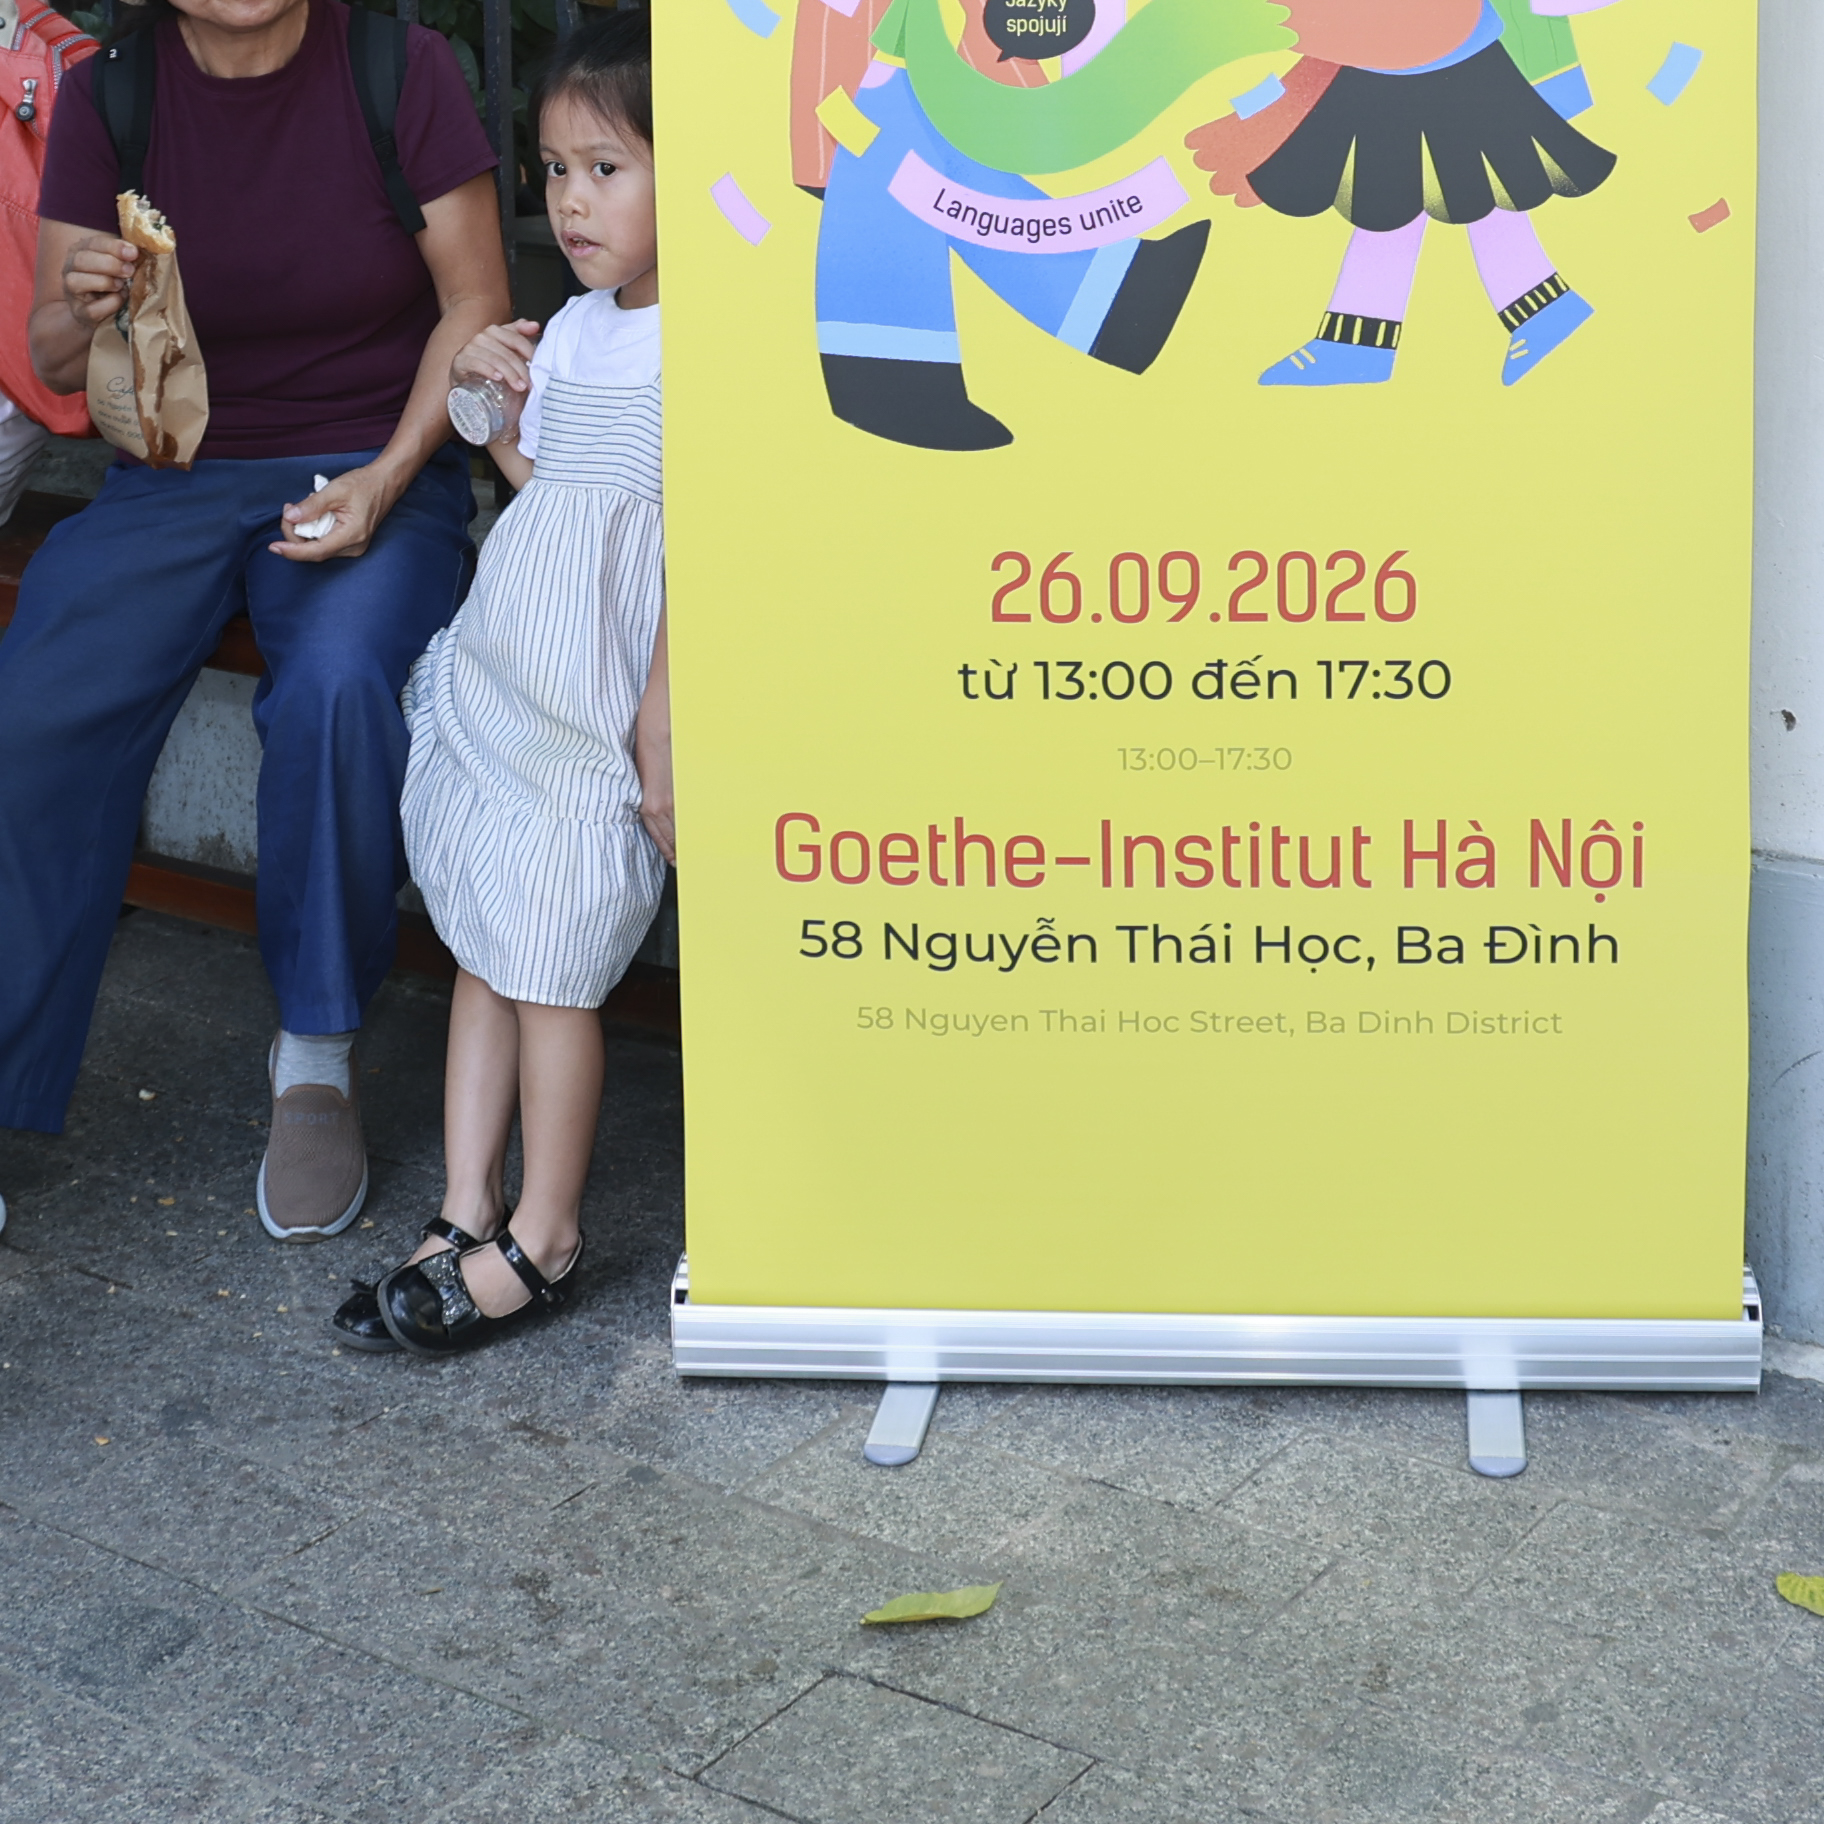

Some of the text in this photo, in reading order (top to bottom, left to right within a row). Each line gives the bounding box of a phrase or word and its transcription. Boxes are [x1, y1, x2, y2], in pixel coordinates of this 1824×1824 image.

[1006, 15, 1067, 37] spojují
[932, 187, 1145, 242] Languages unite
[106, 376, 135, 399] Caf
[990, 549, 1417, 624] 26.09.2026
[957, 654, 1452, 701] từ 13:00 đến 17:30
[774, 811, 1645, 904] Goethe-Institut Hà Nội
[799, 917, 1618, 974] 58 Nguyễn Thái Học, Ba Đình
[856, 1006, 1564, 1039] 58 Nguyen Thai Hoc Street, Ba Dinh District
